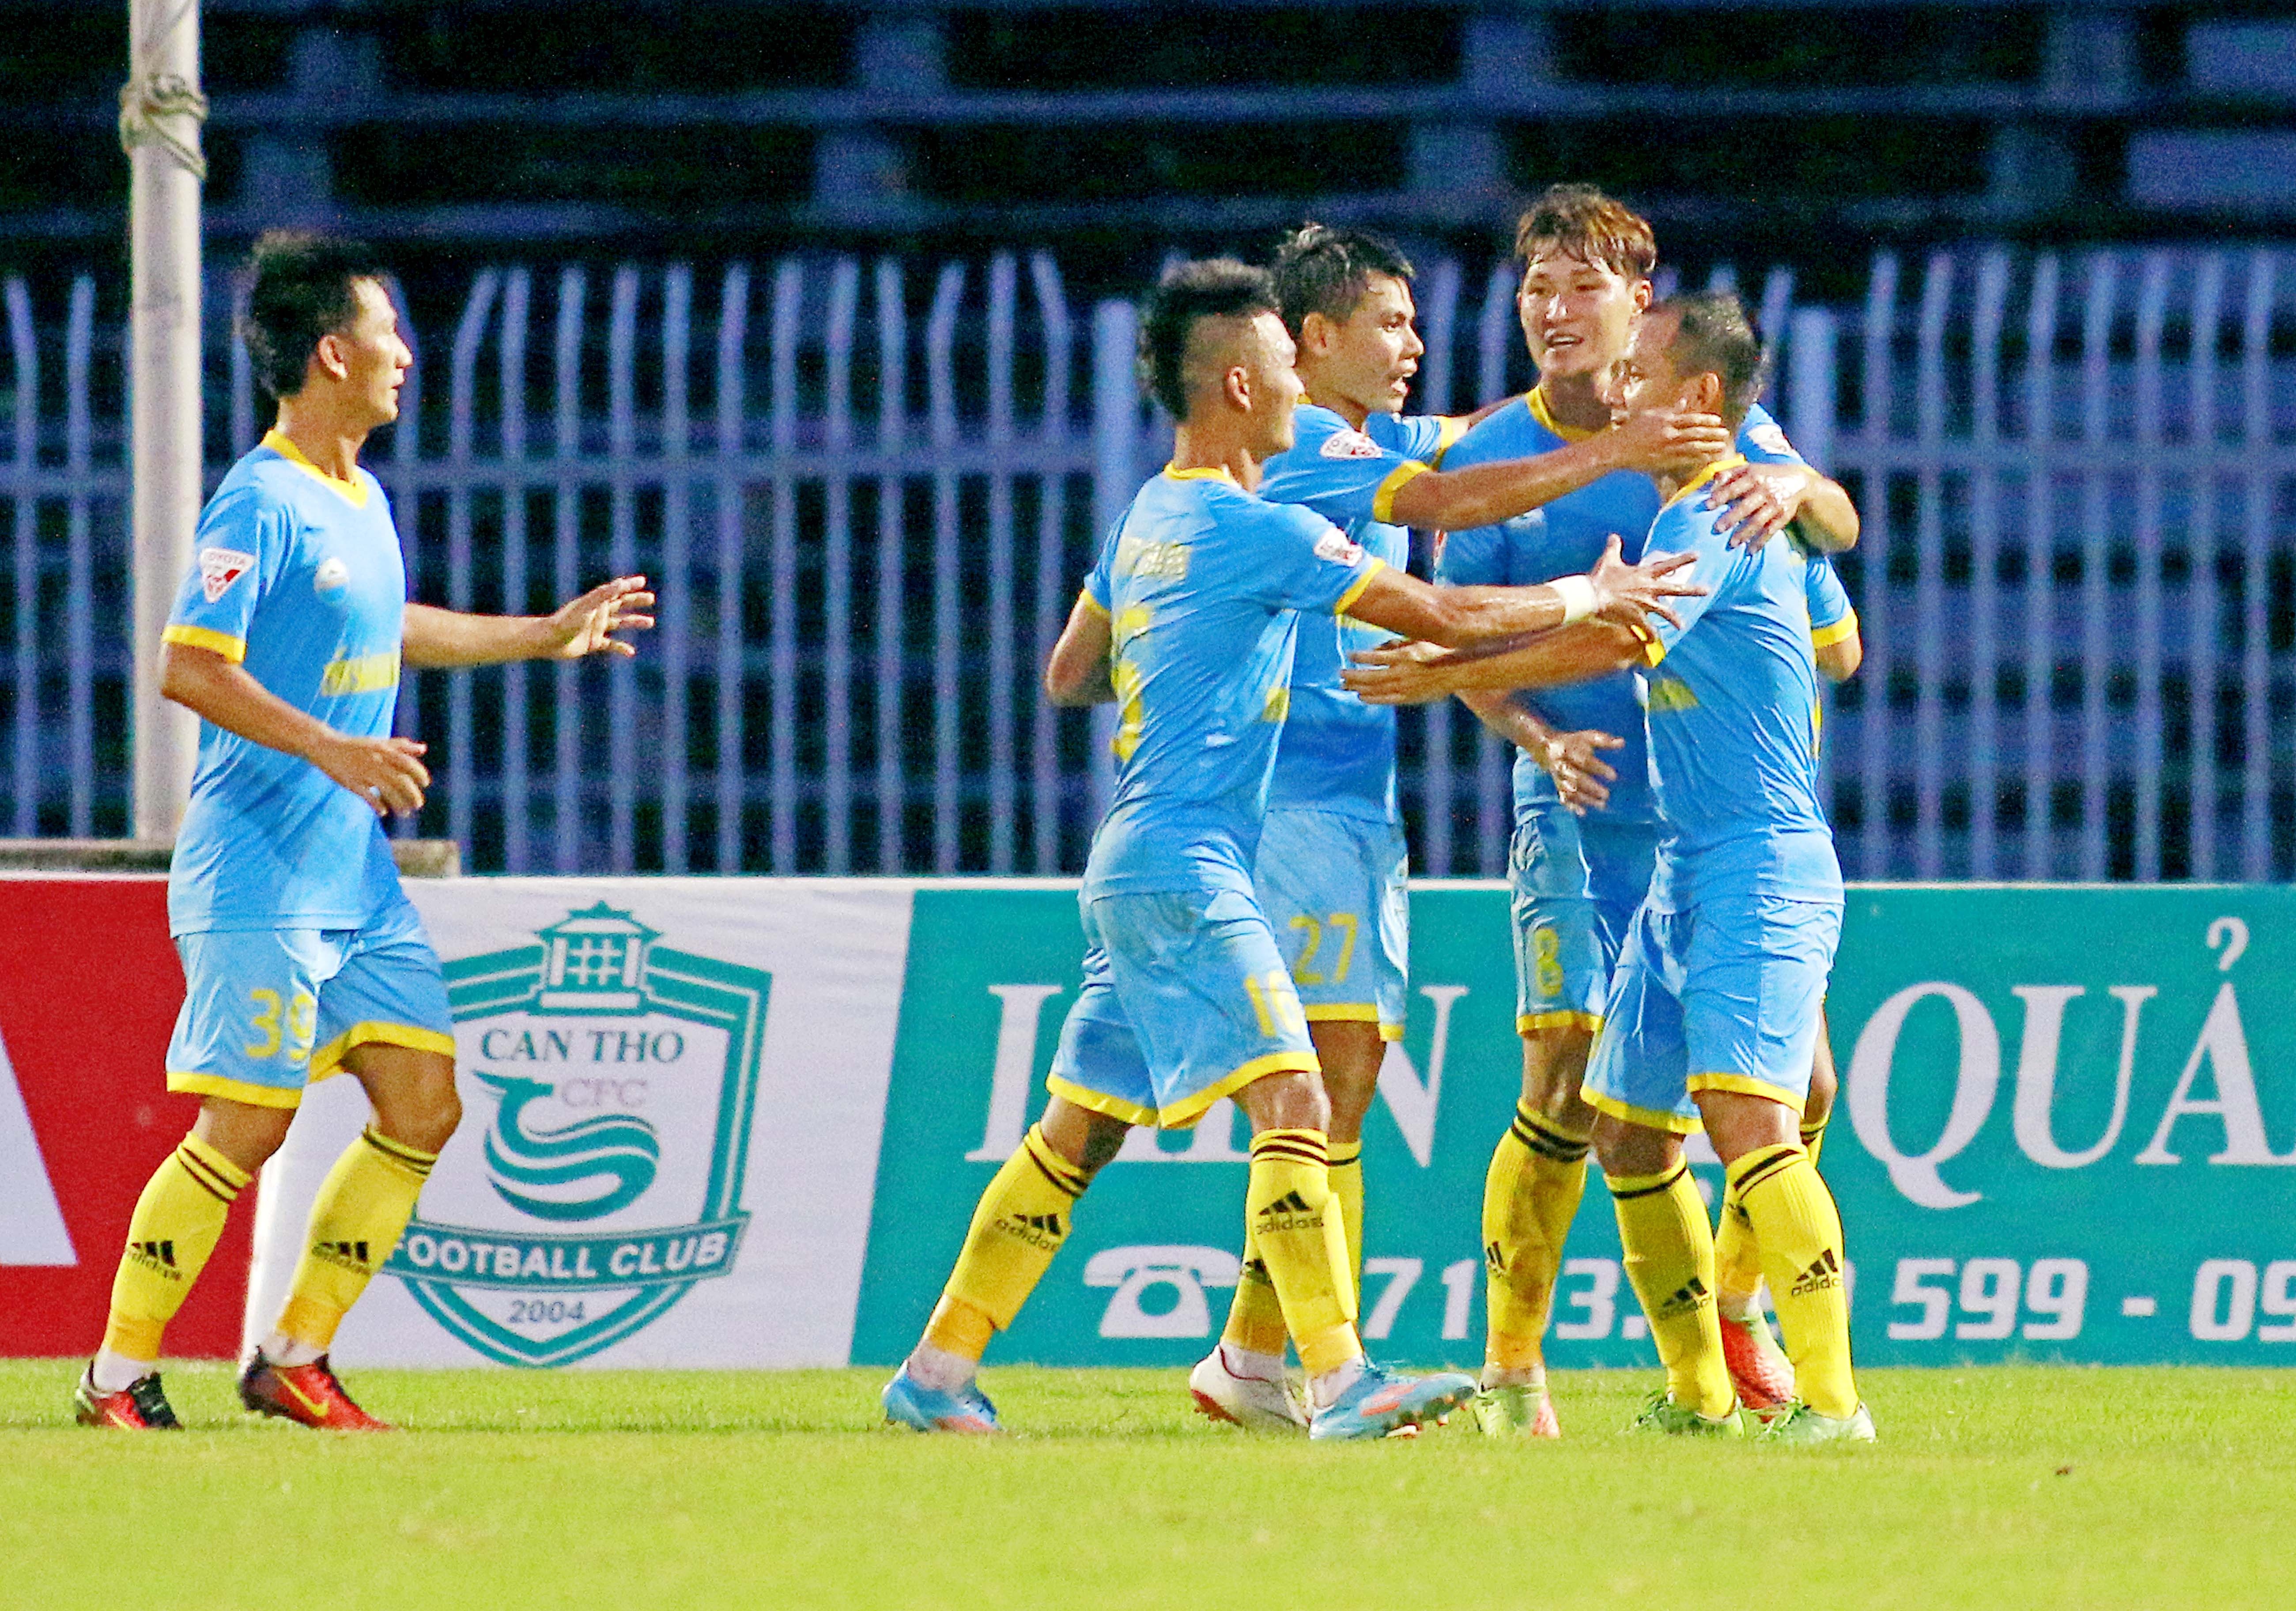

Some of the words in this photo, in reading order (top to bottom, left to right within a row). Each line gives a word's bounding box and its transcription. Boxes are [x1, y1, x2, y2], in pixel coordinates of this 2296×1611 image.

[1289, 913, 1357, 985] 27
[1535, 927, 1564, 997] 8
[245, 989, 315, 1060] 39
[481, 1028, 573, 1061] CAN
[587, 1028, 685, 1063] THO
[562, 1078, 648, 1107] CFC
[1847, 916, 2296, 1209] QUẢ
[391, 1231, 597, 1278] OOTBALL
[610, 1232, 729, 1278] CLUB
[509, 1300, 586, 1324] 2004
[1887, 1258, 2088, 1340] 599
